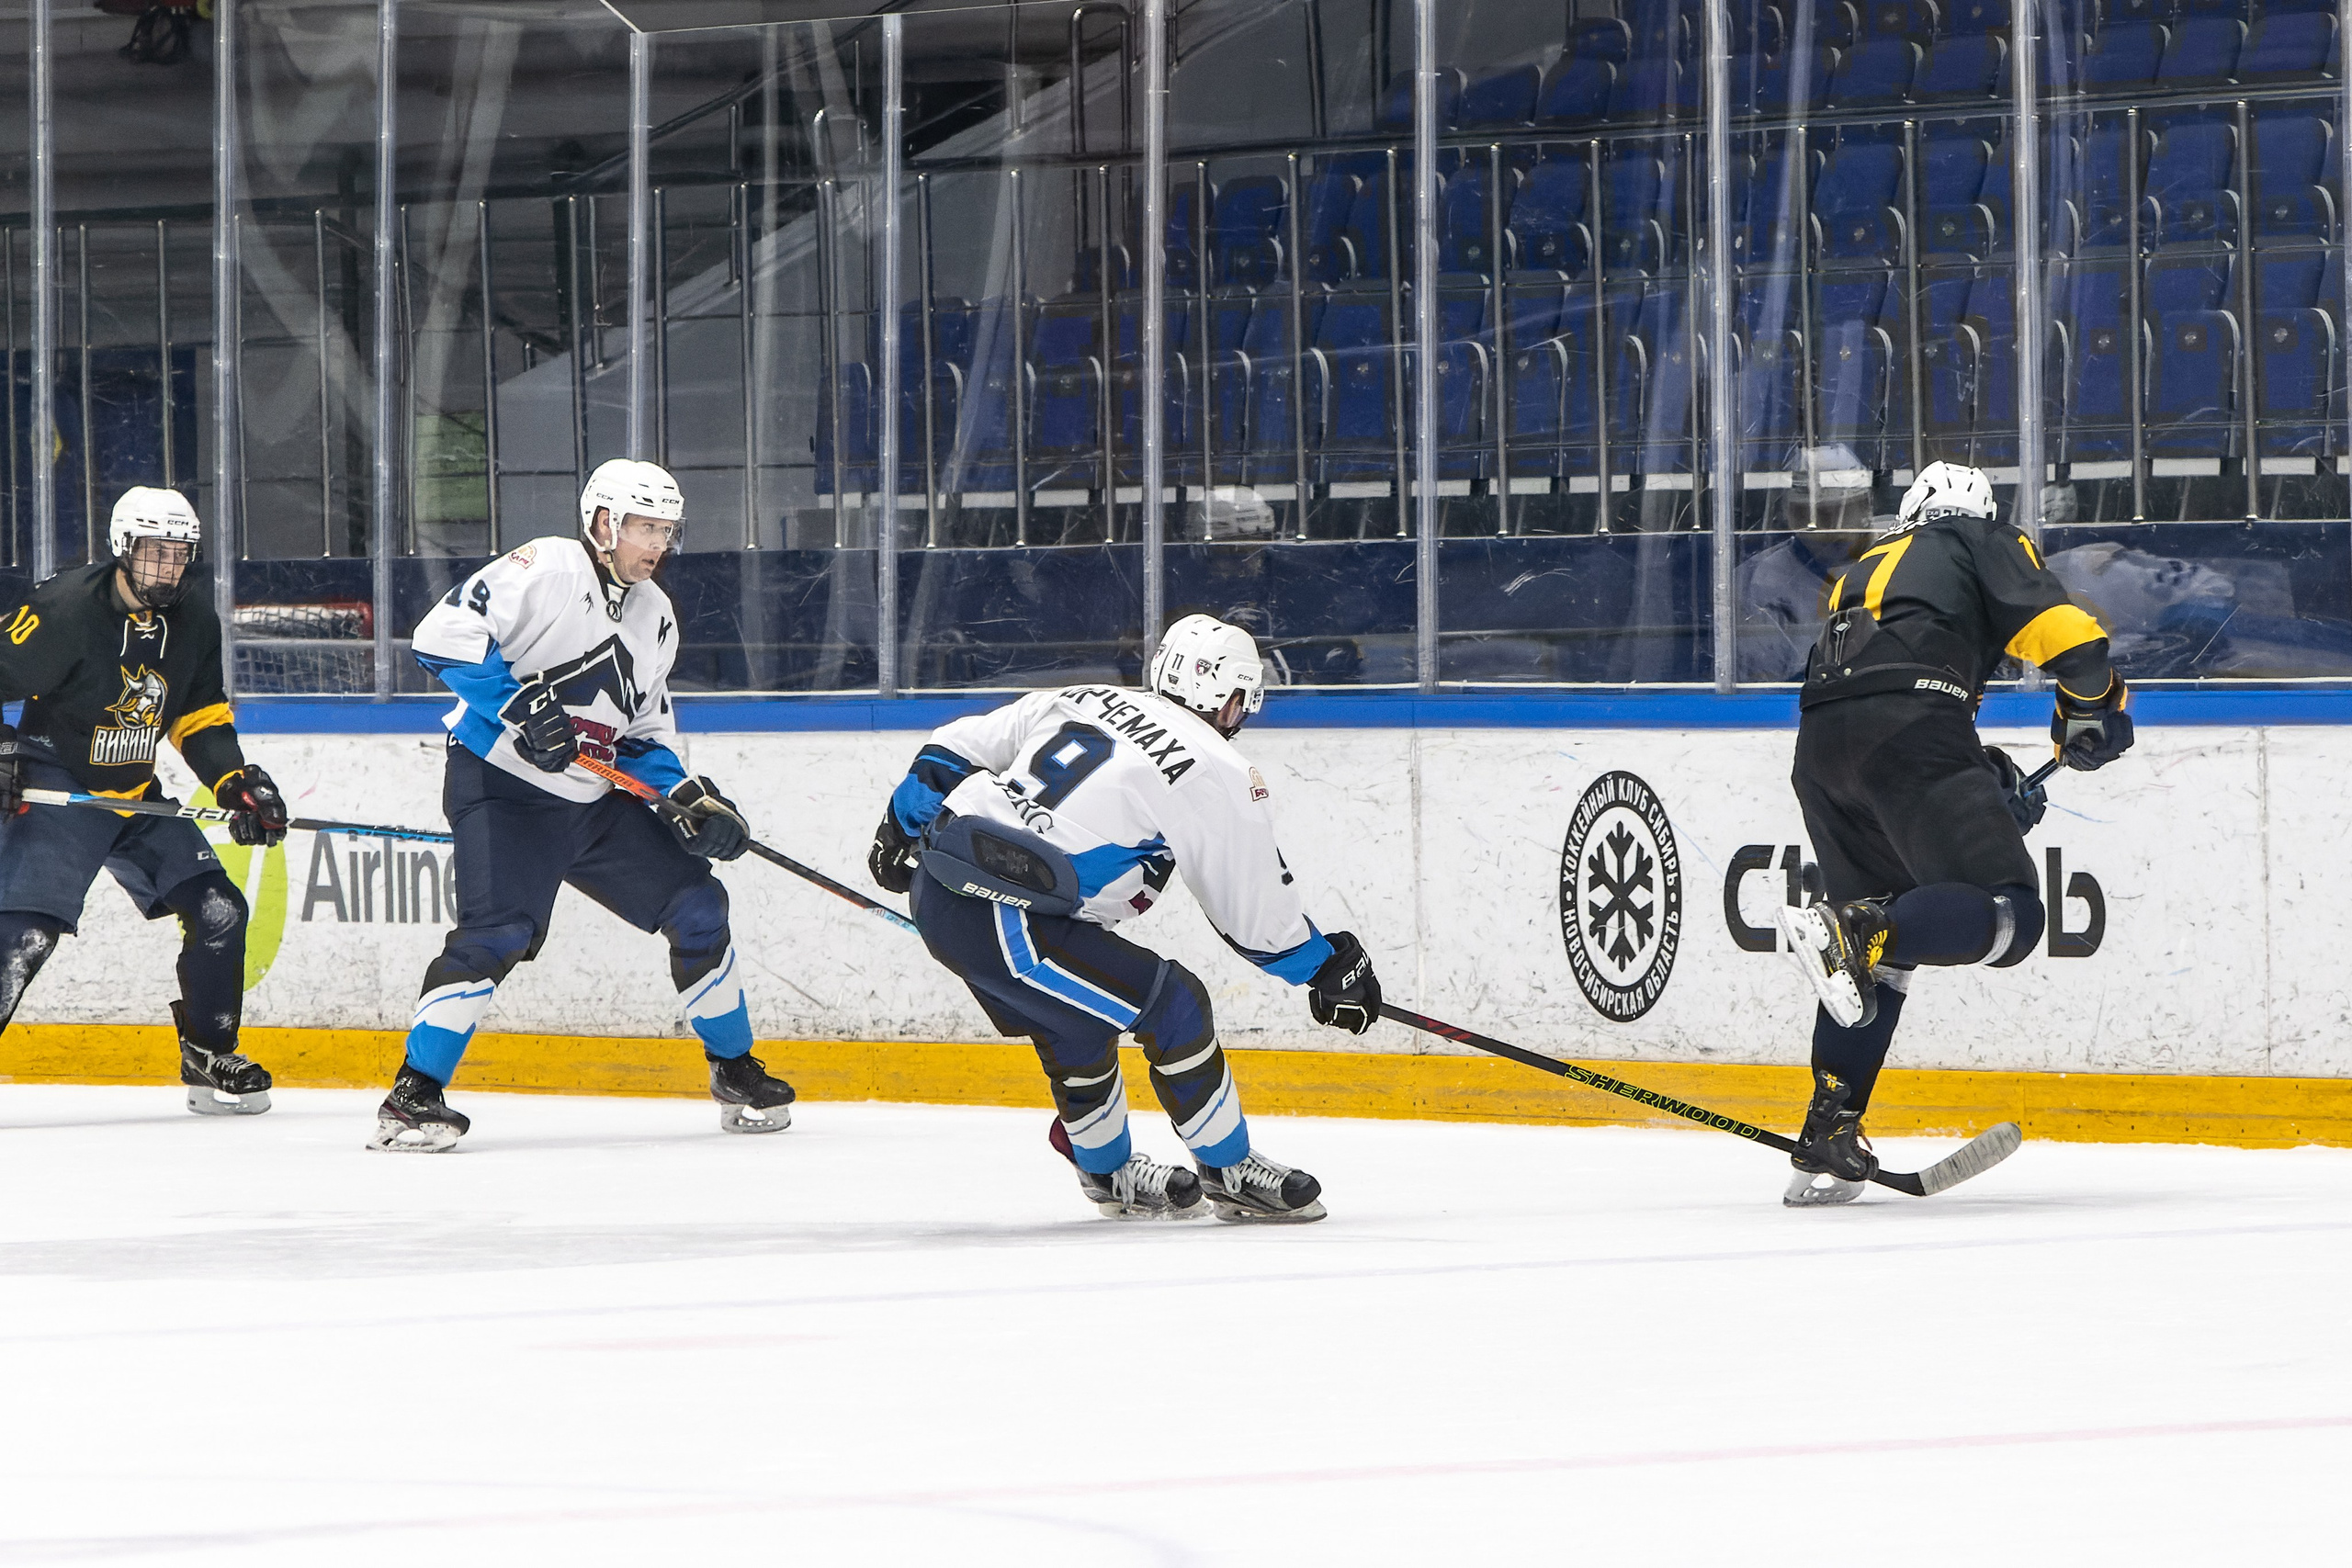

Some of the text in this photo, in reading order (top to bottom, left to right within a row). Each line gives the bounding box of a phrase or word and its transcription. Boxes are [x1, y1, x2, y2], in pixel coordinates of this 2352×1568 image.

[445, 579, 491, 617] 19
[5, 604, 40, 645] 10
[1171, 653, 1185, 671] 11
[93, 727, 160, 763] ВИКИНГ
[1563, 773, 1679, 887] ХОККЕЙНЫЙ КЛУБ СИБИРЬ
[1563, 908, 1679, 1016] НОВОСИБИРСКАЯ ОБЛАСТЬ
[1564, 1066, 1761, 1141] SHERWOOD
